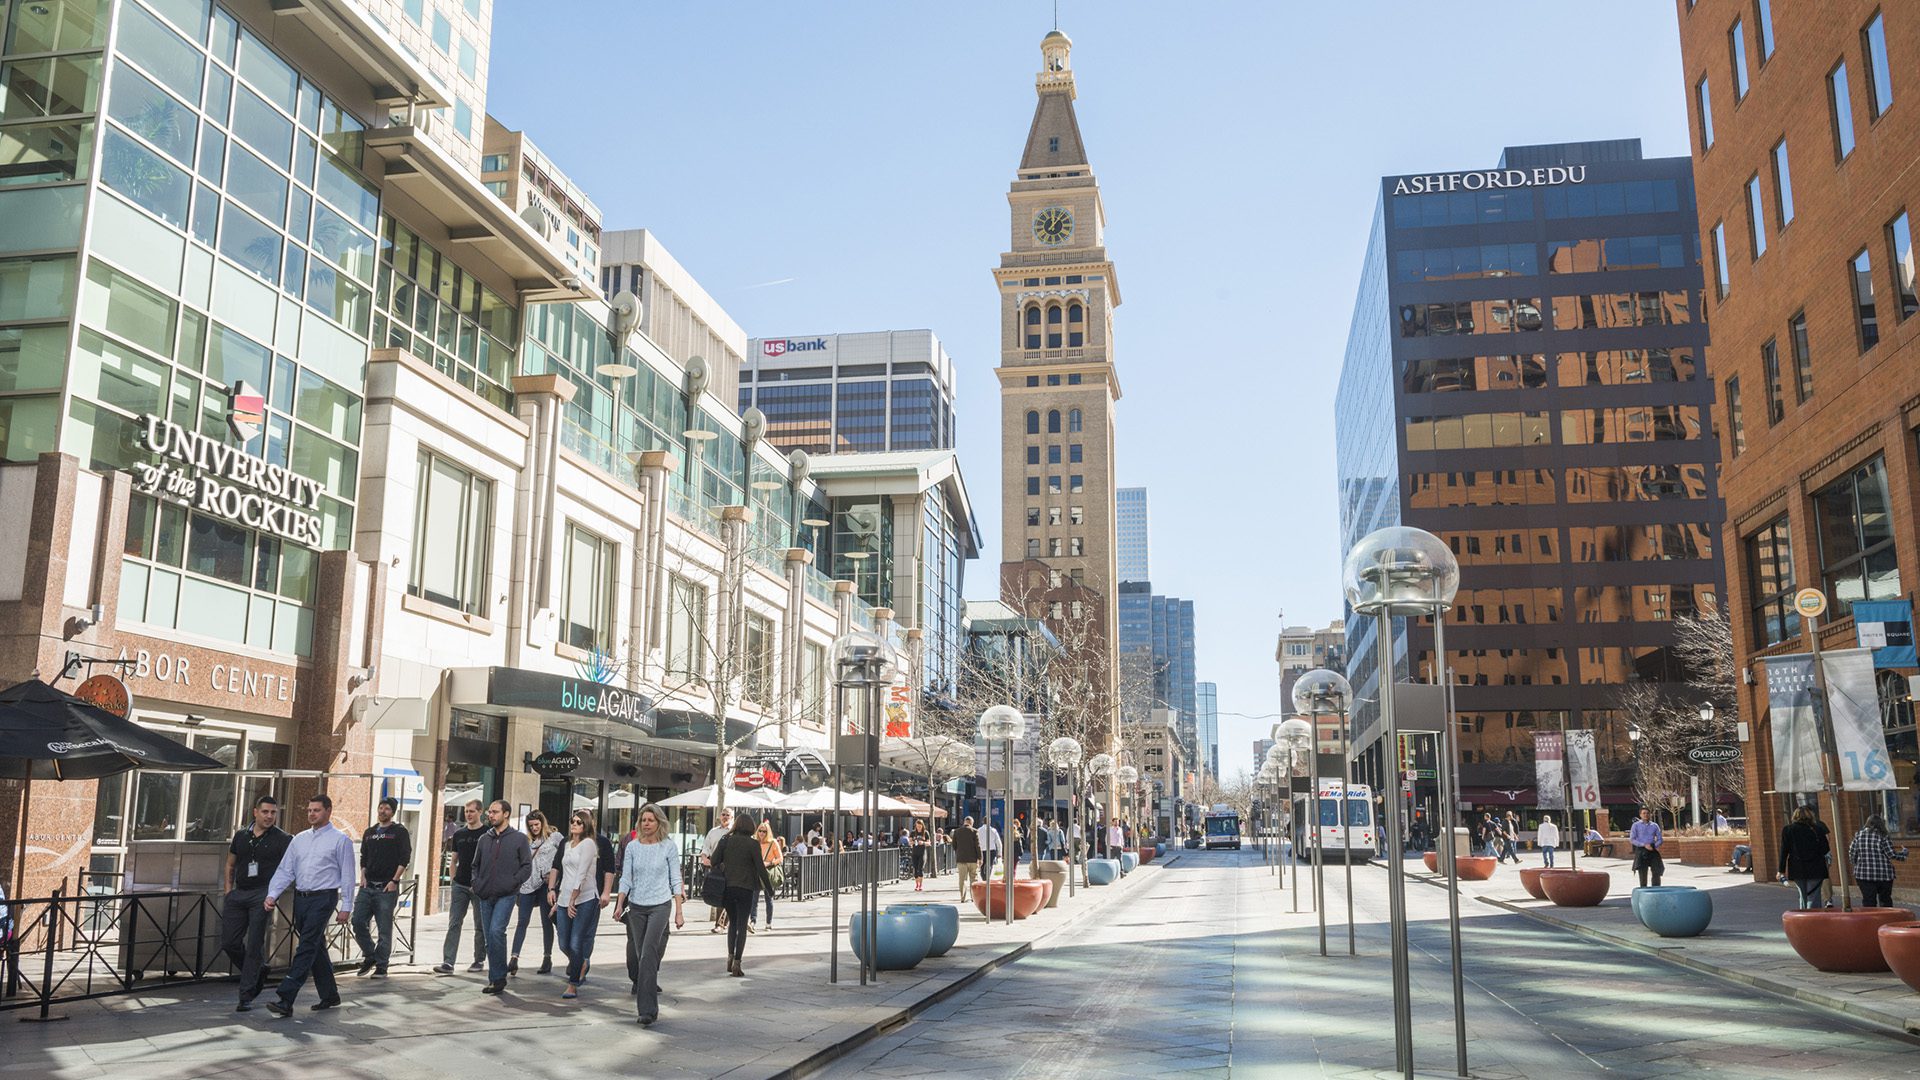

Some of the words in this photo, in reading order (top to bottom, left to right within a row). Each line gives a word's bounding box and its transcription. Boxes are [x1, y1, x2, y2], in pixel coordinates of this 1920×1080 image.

[1393, 165, 1587, 196] ASHFORD.EDU
[786, 338, 827, 352] bank
[145, 412, 326, 512] UNIVERSITY
[143, 466, 164, 492] of
[167, 469, 196, 499] the
[199, 476, 322, 549] ROCKIES
[112, 646, 191, 687] ABOR
[1768, 666, 1798, 676] 16TH
[1768, 674, 1815, 685] STREET
[1769, 684, 1803, 694] MALL
[562, 681, 597, 712] blue
[597, 688, 641, 722] AGAVE
[551, 756, 576, 765] AGAVE
[1692, 750, 1739, 758] OVERLAND
[1844, 748, 1888, 781] 16
[1574, 784, 1597, 803] 16
[30, 832, 51, 841] ABOR
